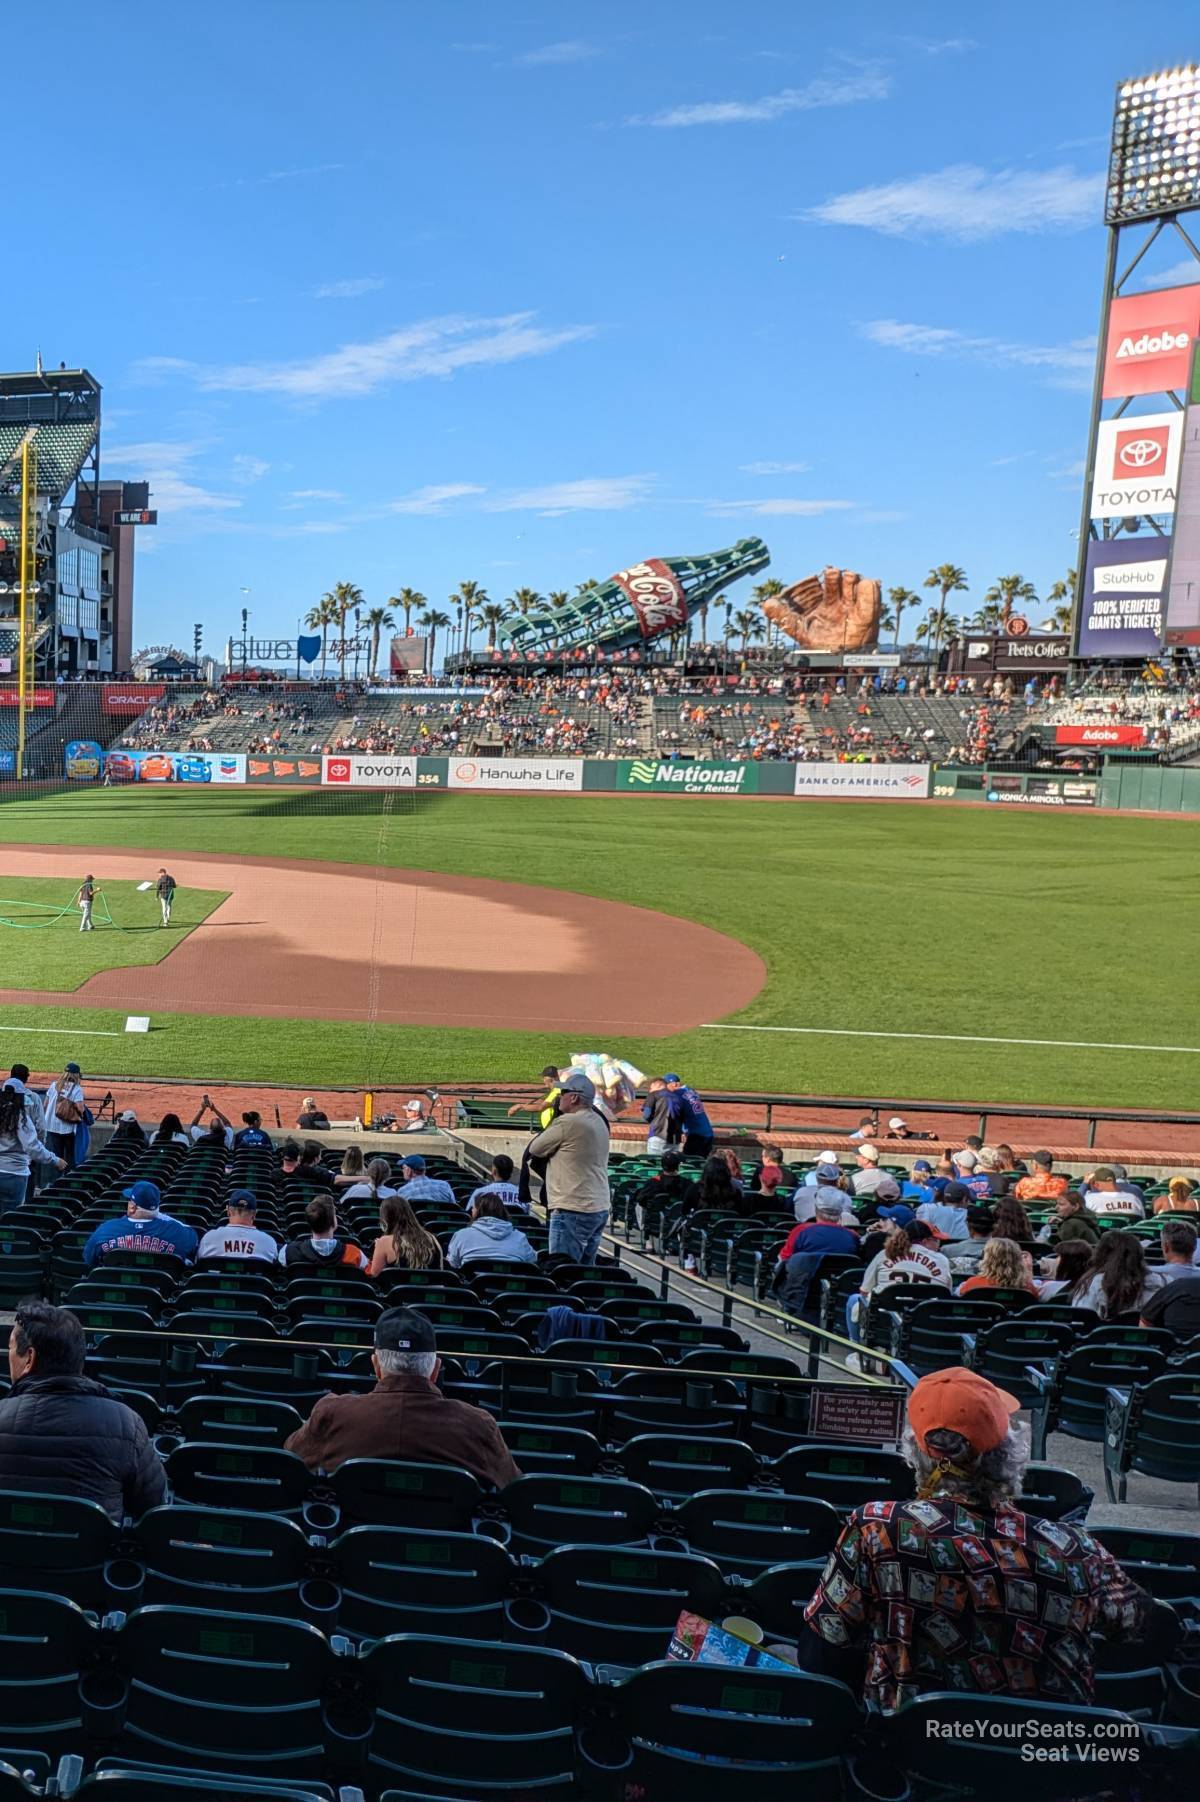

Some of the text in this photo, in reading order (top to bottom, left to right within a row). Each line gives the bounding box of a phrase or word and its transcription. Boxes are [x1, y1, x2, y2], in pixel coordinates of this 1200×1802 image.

[1116, 332, 1190, 358] Adobe
[1097, 488, 1176, 507] TOYOTA
[120, 513, 130, 522] WE
[130, 513, 141, 522] ARE
[1102, 571, 1155, 585] StubHub
[1093, 598, 1160, 615] 100% VERIFIED
[1088, 613, 1162, 629] GIANTS TICKETS
[1034, 641, 1066, 657] Coffee
[108, 695, 158, 704] ORACLE
[1082, 729, 1119, 741] Adobe
[355, 765, 412, 777] TOYOTA
[480, 767, 575, 782] Hanwha Life
[656, 764, 745, 784] National
[418, 774, 439, 784] 354
[799, 777, 899, 787] BANK OF AMERICA
[685, 783, 740, 793] Car Rental
[933, 785, 956, 797] 399
[999, 793, 1029, 803] KONICA
[1029, 794, 1065, 805] MINOLTA
[1105, 1201, 1132, 1211] CLARK
[224, 1240, 255, 1254] MAYS
[823, 1395, 894, 1407] For your safety and
[823, 1405, 835, 1413] the
[836, 1407, 858, 1416] safety
[822, 1413, 845, 1422] Please
